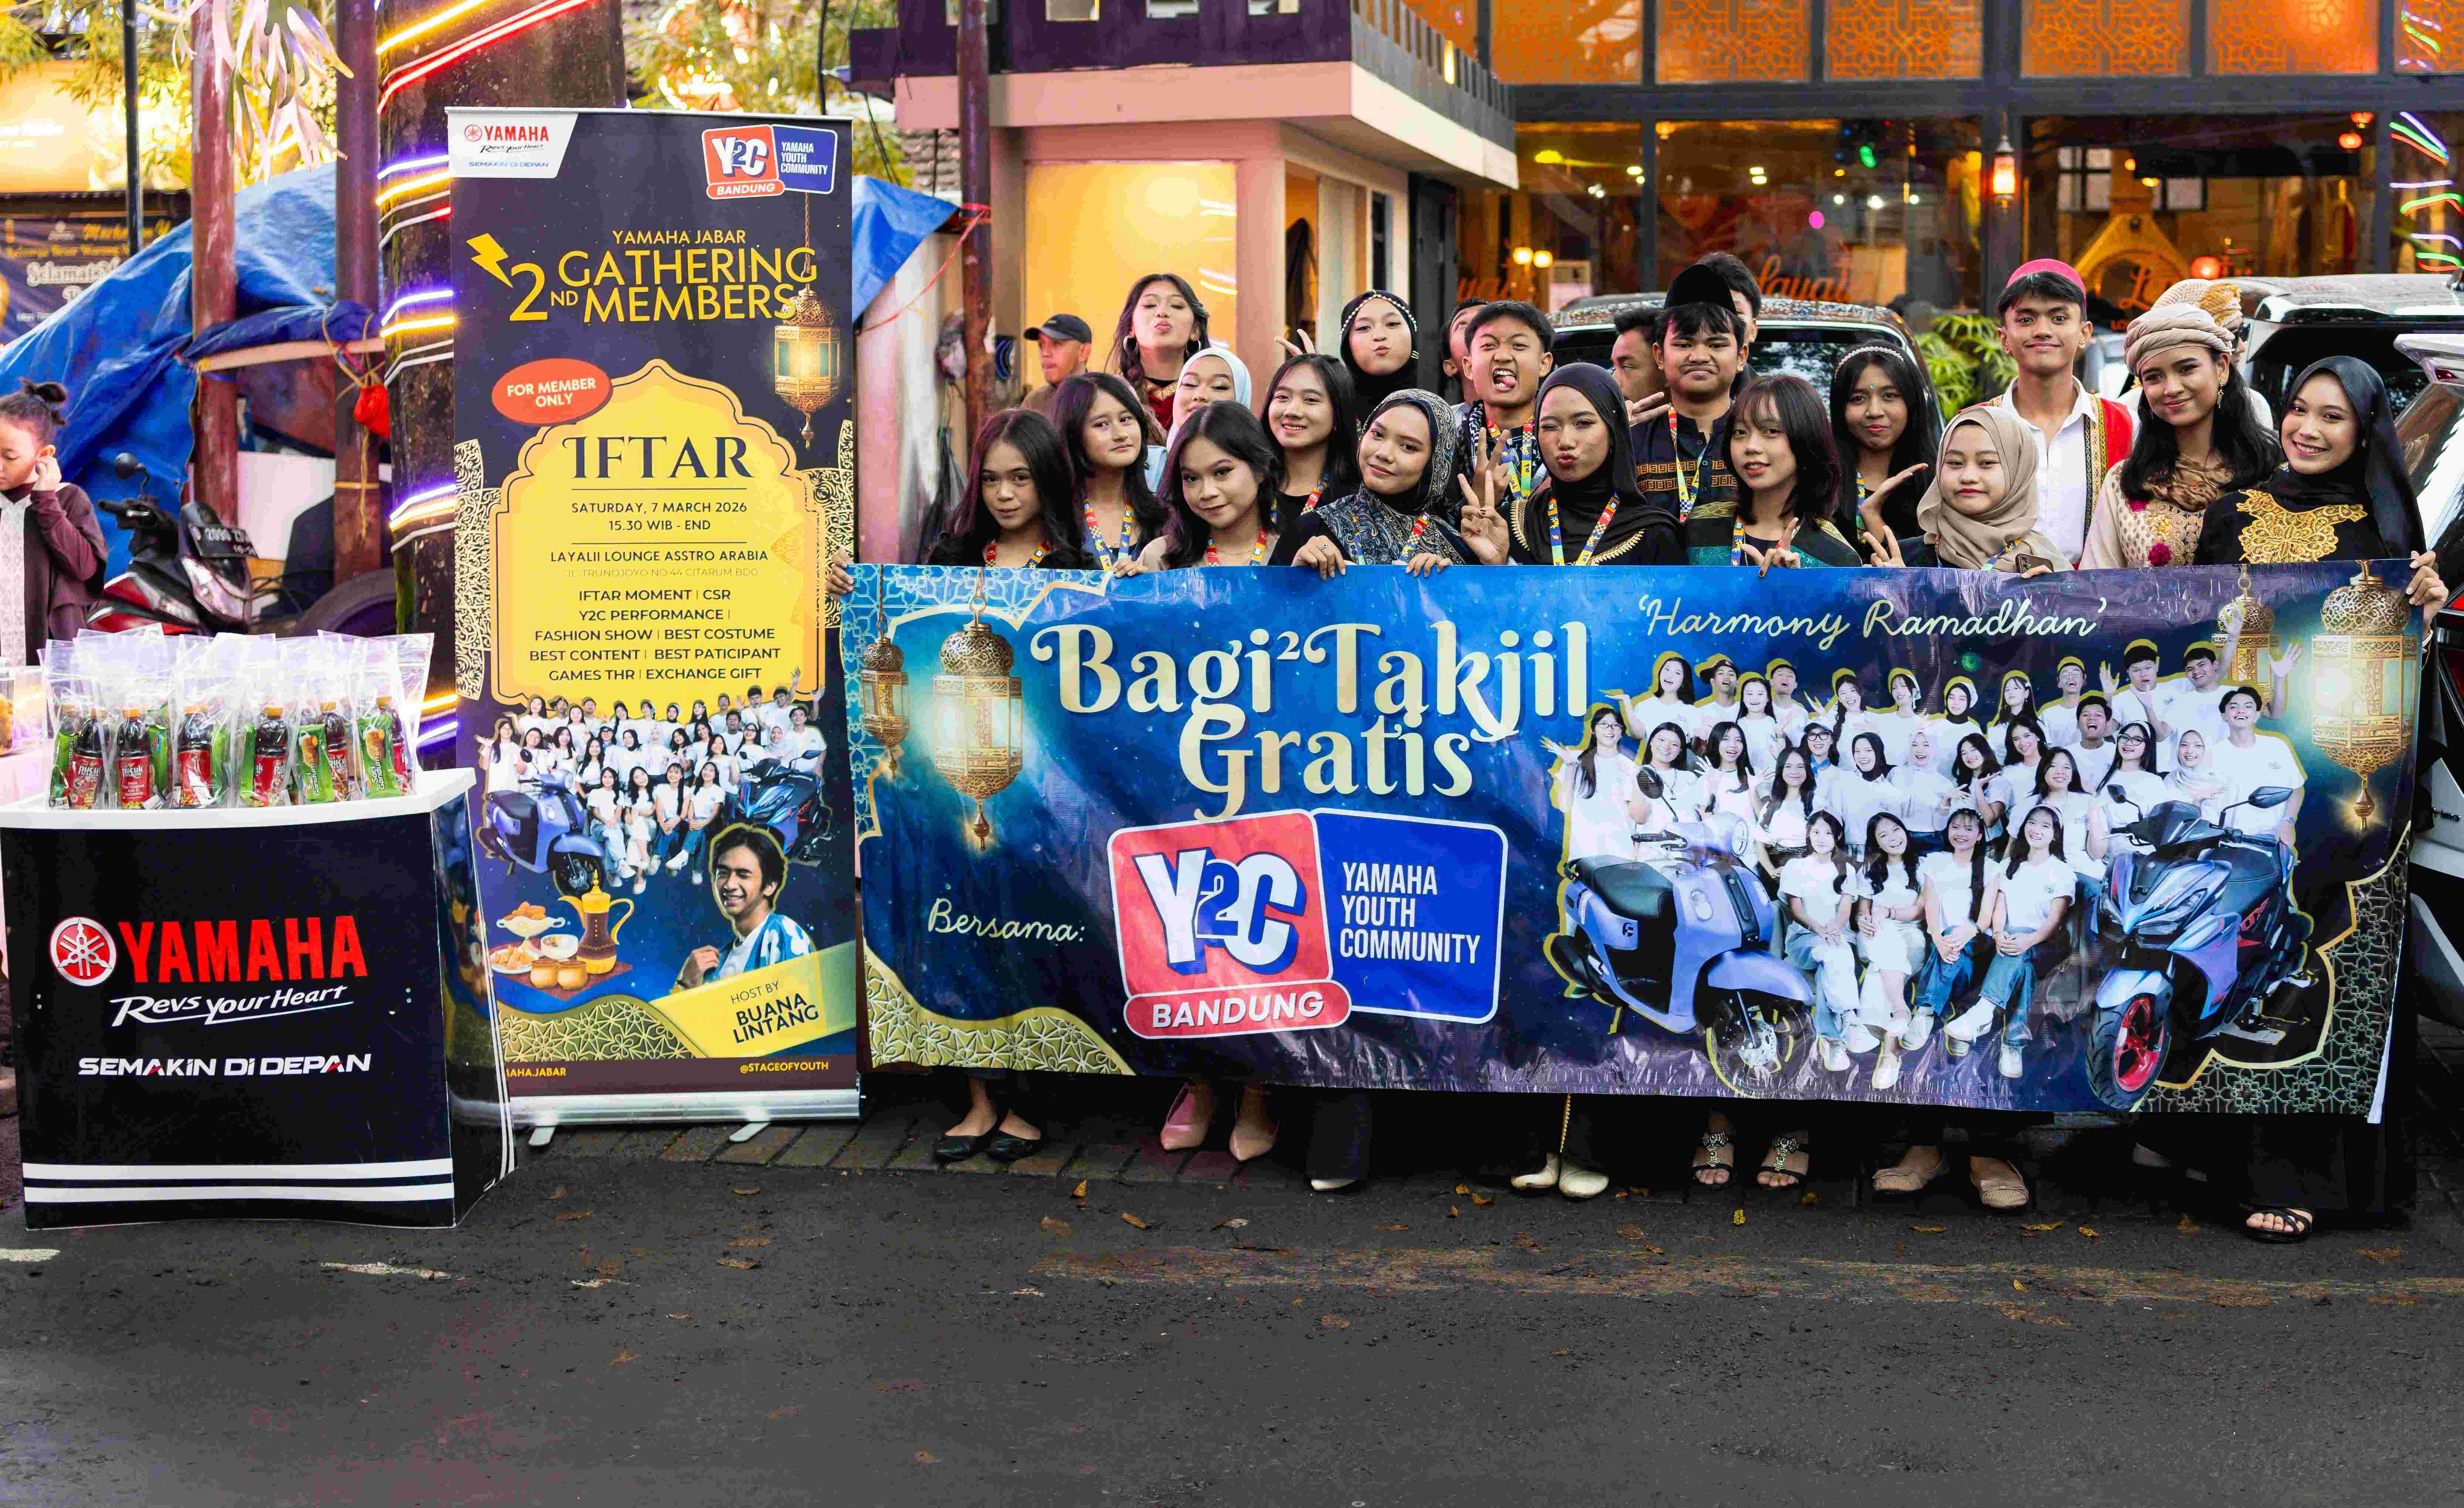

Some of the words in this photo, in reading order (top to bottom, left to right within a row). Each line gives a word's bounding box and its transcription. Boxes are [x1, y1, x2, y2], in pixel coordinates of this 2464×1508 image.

[484, 125, 549, 142] YAMAHA
[479, 143, 505, 153] Revs
[506, 144, 522, 153] your
[711, 136, 769, 177] Y2C
[780, 141, 814, 153] YAMAHA
[780, 152, 807, 163] YOUTH
[780, 162, 828, 175] COMMUNITY
[716, 182, 776, 196] BANDUNG
[612, 230, 692, 244] YAMAHA
[695, 230, 746, 245] JABAR
[558, 247, 817, 287] GATHERING
[584, 284, 796, 322] MEMBERS
[506, 382, 536, 398] FOR
[537, 376, 597, 395] MEMBER
[535, 392, 573, 408] ONLY
[562, 437, 753, 479] IFTAR
[572, 503, 646, 514] SATURDAY,
[651, 503, 658, 512] 7
[663, 503, 711, 512] MARCH
[716, 503, 746, 512] 2026
[609, 520, 643, 531] 15.30
[647, 520, 672, 530] WIB
[685, 520, 710, 530] END
[550, 551, 600, 562] LAYALII
[605, 551, 660, 561] LOUNGE
[665, 550, 714, 562] ASSTRO
[719, 550, 767, 560] ARABIA
[582, 568, 648, 578] TRUNOJOYO
[686, 568, 732, 577] CITARUM
[735, 568, 758, 577] BDG
[580, 591, 621, 600] IFTAR
[626, 590, 692, 601] MOMENT
[703, 590, 730, 600] CSR
[579, 611, 606, 621] Y2C
[611, 609, 723, 620] PERFORMANCE
[535, 630, 600, 641] FASHION
[605, 630, 653, 640] SHOW
[665, 629, 700, 639] BEST
[704, 629, 775, 639] COSTUME
[530, 651, 566, 662] BEST
[570, 650, 640, 660] CONTENT
[655, 649, 691, 659] BEST
[695, 648, 781, 659] PATICIPANT
[549, 670, 601, 680] GAMES
[605, 670, 635, 680] THR
[647, 668, 726, 680] EXCHANGE
[730, 668, 762, 678] GIFT
[1303, 620, 1587, 742] Takjil
[375, 756, 385, 790] Gandum
[1178, 707, 1473, 822] Gratis
[310, 763, 320, 796] Gandum
[1342, 862, 1438, 896] YAMAHA
[927, 897, 1085, 943] Bersama:
[1132, 847, 1306, 976] Y2C
[1340, 894, 1417, 928] YOUTH
[118, 914, 368, 984] YAMAHA
[1338, 928, 1482, 965] COMMUNITY
[731, 988, 763, 1004] HOST
[756, 981, 779, 995] BY
[109, 995, 201, 1028] Revs
[203, 995, 271, 1025] your
[271, 985, 348, 1009] Heart
[736, 993, 808, 1027] BUANA
[1152, 991, 1324, 1029] BANDUNG
[733, 1004, 820, 1045] LINTANG
[260, 1054, 371, 1074] DEPAN
[739, 1061, 828, 1074] @STAGEOFYOUTH
